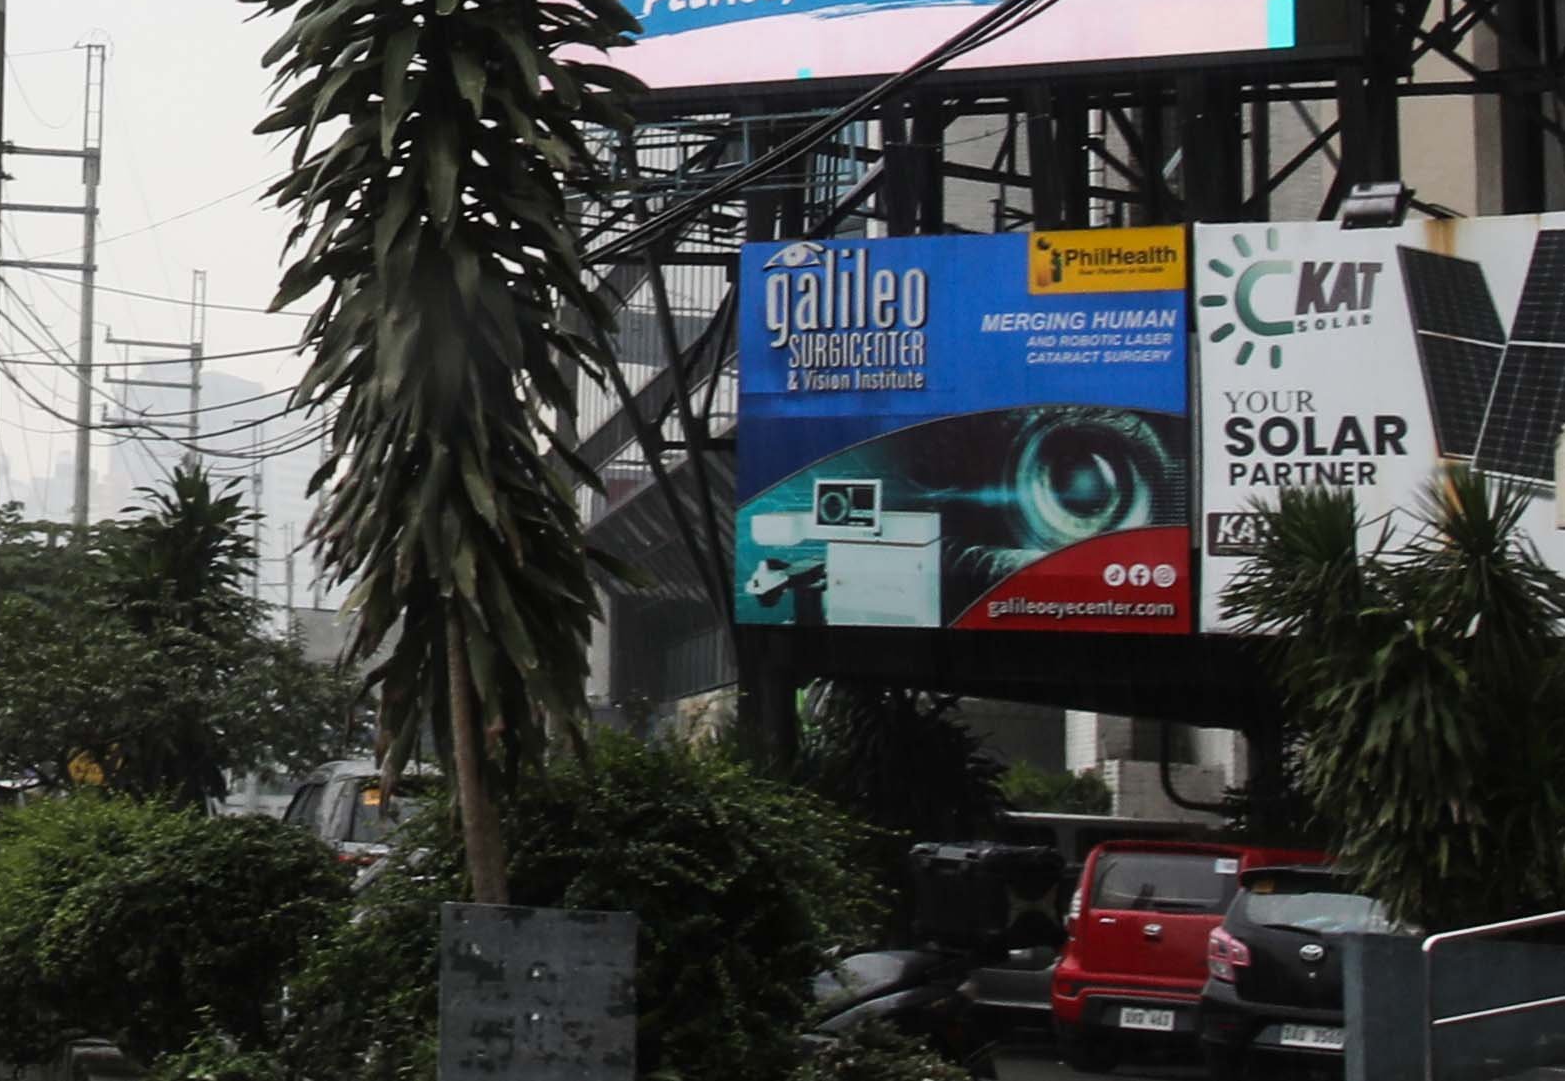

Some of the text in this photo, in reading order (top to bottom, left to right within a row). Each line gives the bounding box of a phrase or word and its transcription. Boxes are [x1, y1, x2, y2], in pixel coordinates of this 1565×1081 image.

[1065, 246, 1177, 267] PhilHealth
[765, 246, 928, 347] galileo
[981, 309, 1177, 332] MERGING HUMAN
[1296, 315, 1373, 333] SOLAR
[788, 329, 925, 369] SURGICENTER
[1027, 333, 1172, 347] AND ROBOTIC LASER
[1027, 350, 1172, 364] CATARACT SURGERY
[787, 370, 924, 390] & Vision Institute
[1223, 391, 1316, 414] YOUR
[1224, 415, 1408, 457] SOLAR
[1229, 462, 1377, 487] PARTNER
[987, 598, 1175, 620] galileoeyecenter.com
